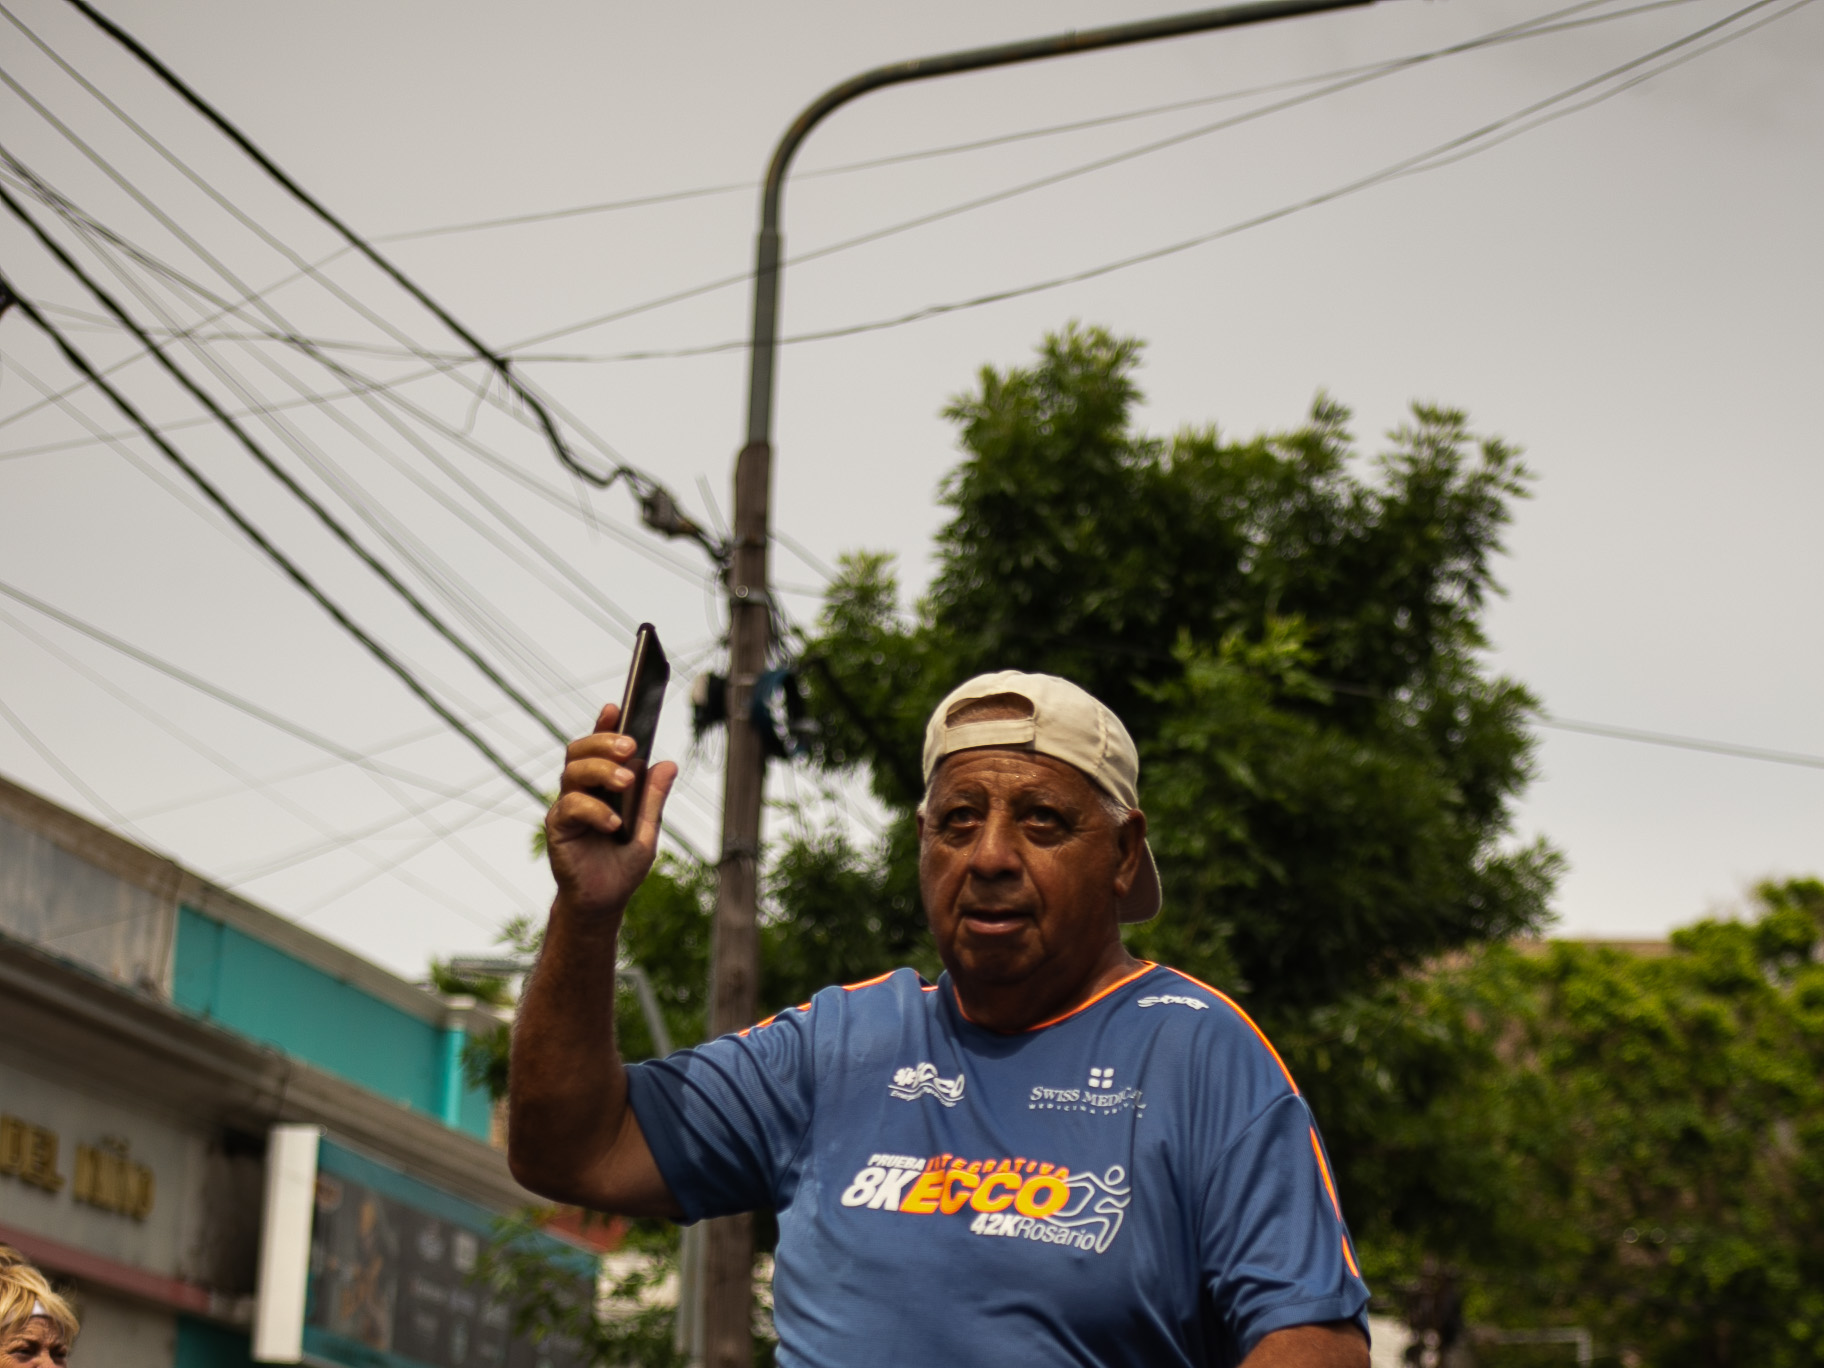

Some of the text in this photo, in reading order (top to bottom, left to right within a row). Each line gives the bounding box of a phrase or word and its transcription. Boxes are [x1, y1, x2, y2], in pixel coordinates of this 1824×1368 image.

[1029, 1086, 1081, 1102] SWISS
[867, 1153, 926, 1171] PRUEBA
[840, 1166, 1071, 1220] 8K ECCO
[1015, 1216, 1096, 1251] Rosario
